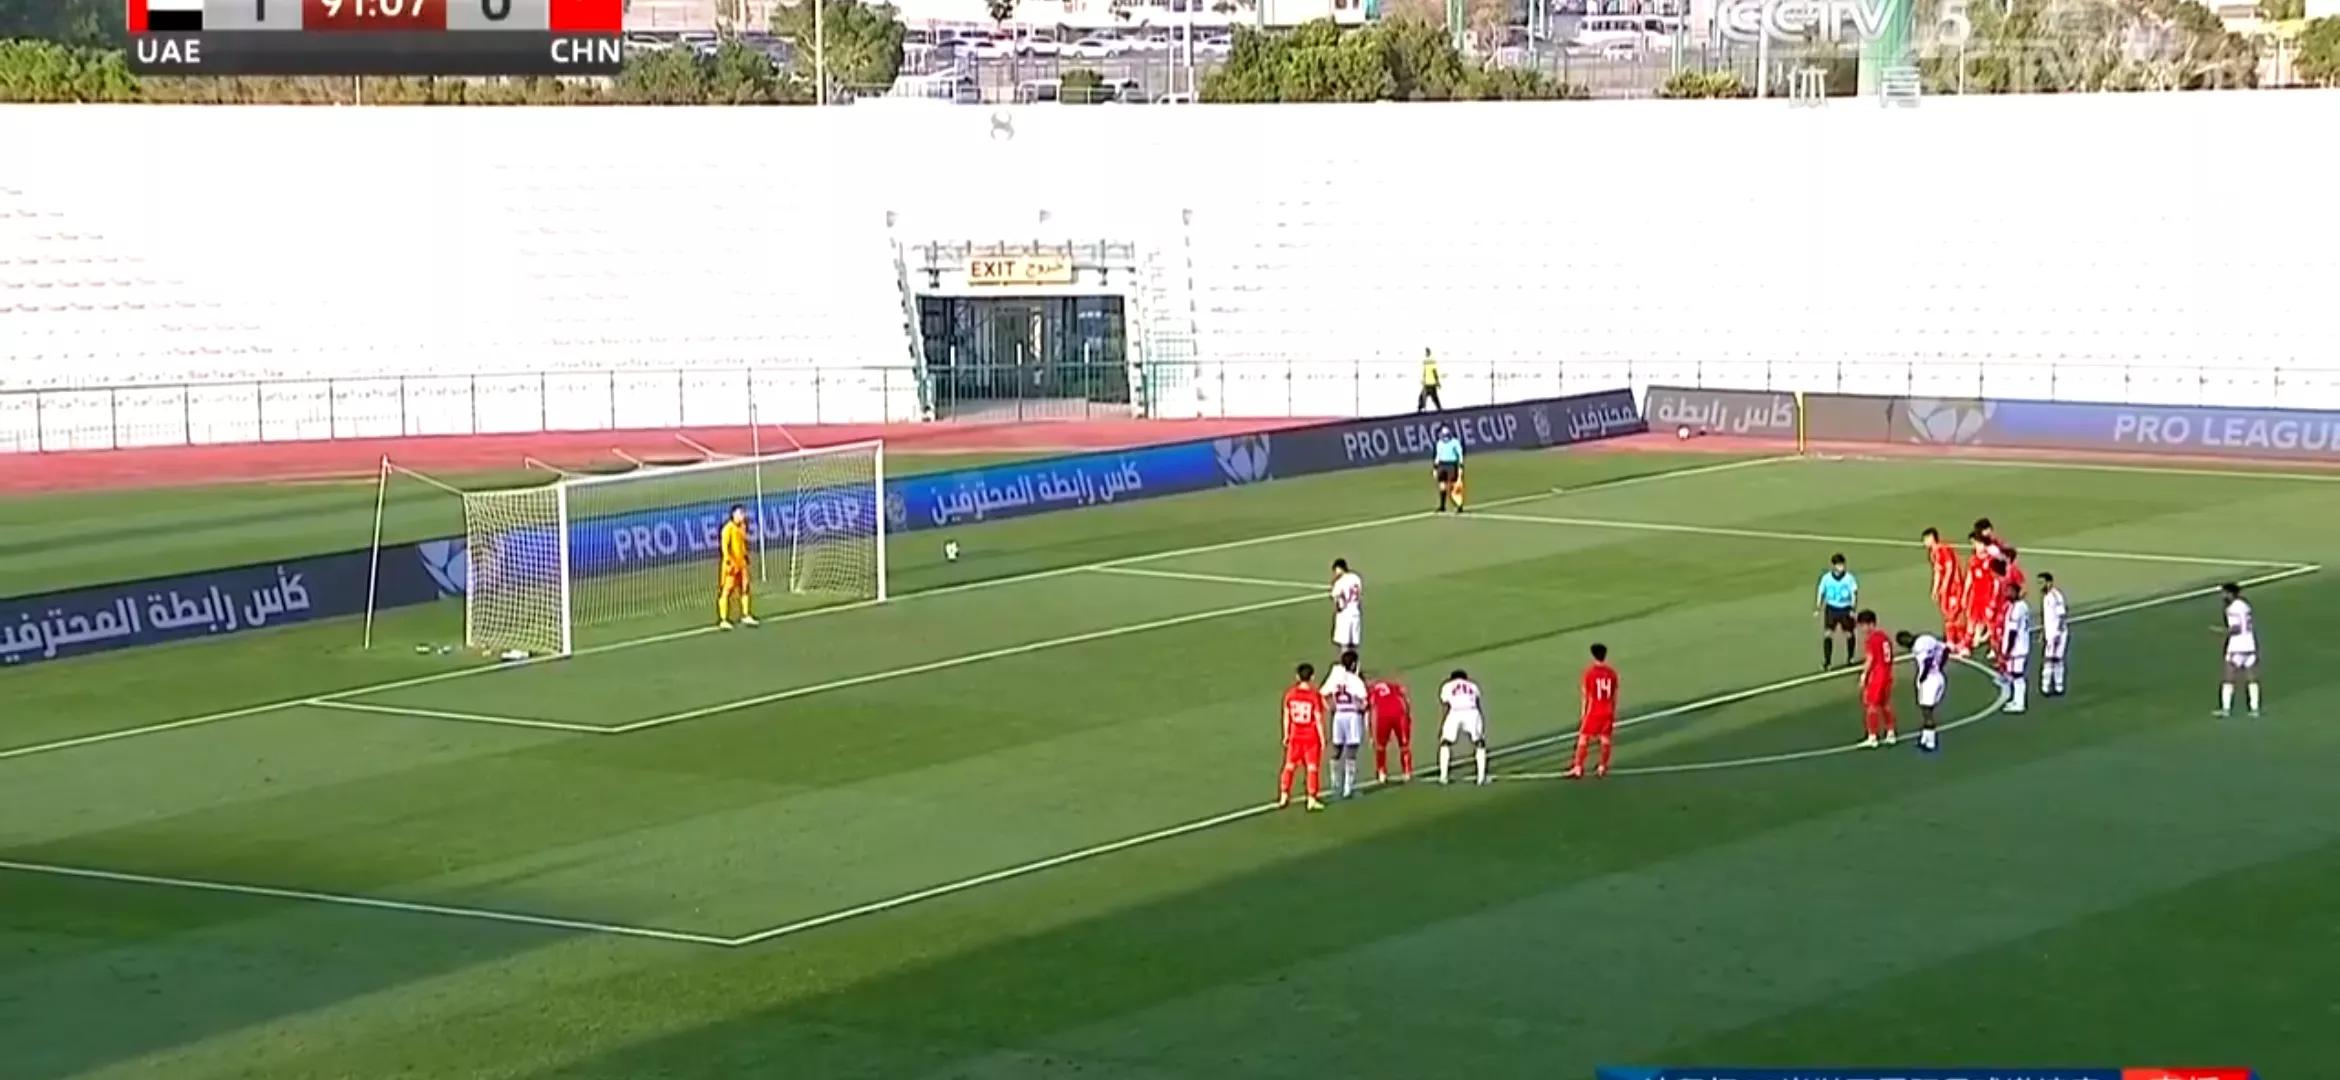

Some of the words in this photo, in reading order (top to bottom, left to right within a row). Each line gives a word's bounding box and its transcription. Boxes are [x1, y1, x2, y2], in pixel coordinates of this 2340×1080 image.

[971, 260, 1016, 277] EXIT
[1343, 427, 1390, 462] PRO
[1477, 412, 1518, 444] CUP
[2114, 413, 2191, 445] PRO
[613, 521, 679, 561] PRO
[802, 496, 861, 533] CUP
[147, 584, 238, 631] رابطة
[243, 565, 310, 627] كأس
[1595, 678, 1611, 701] 14
